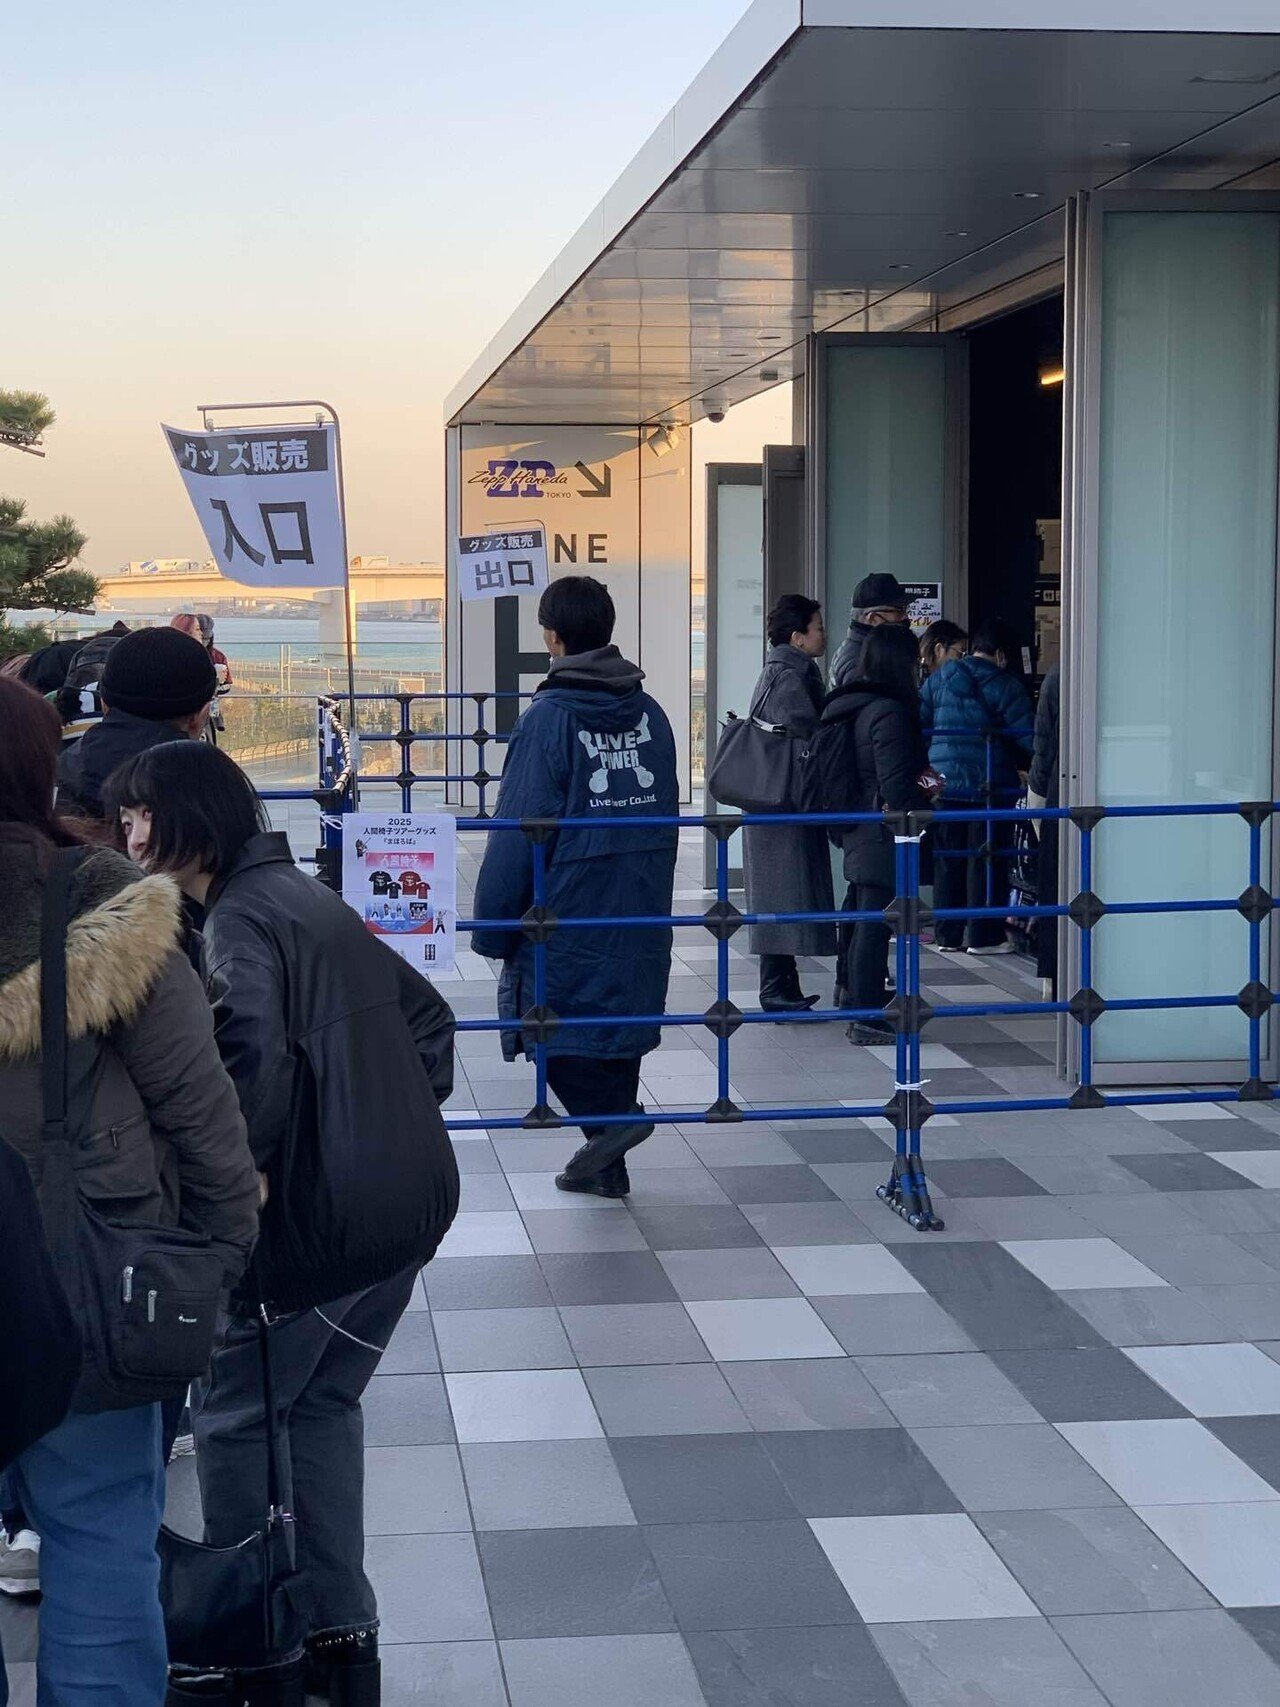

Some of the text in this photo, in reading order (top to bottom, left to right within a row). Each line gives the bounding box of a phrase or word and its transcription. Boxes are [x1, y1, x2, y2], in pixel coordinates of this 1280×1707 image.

[184, 439, 309, 472] グッズ販売
[468, 470, 568, 489] Zepp Haneda
[209, 497, 314, 567] 入口
[469, 534, 534, 552] グッズ販売
[554, 533, 608, 563] NE
[475, 559, 535, 591] 出口
[594, 731, 636, 749] LIVE
[363, 826, 437, 836] 人間椅子ツアーグッズ
[388, 818, 412, 826] 2025
[383, 837, 417, 846] 『まほろば』
